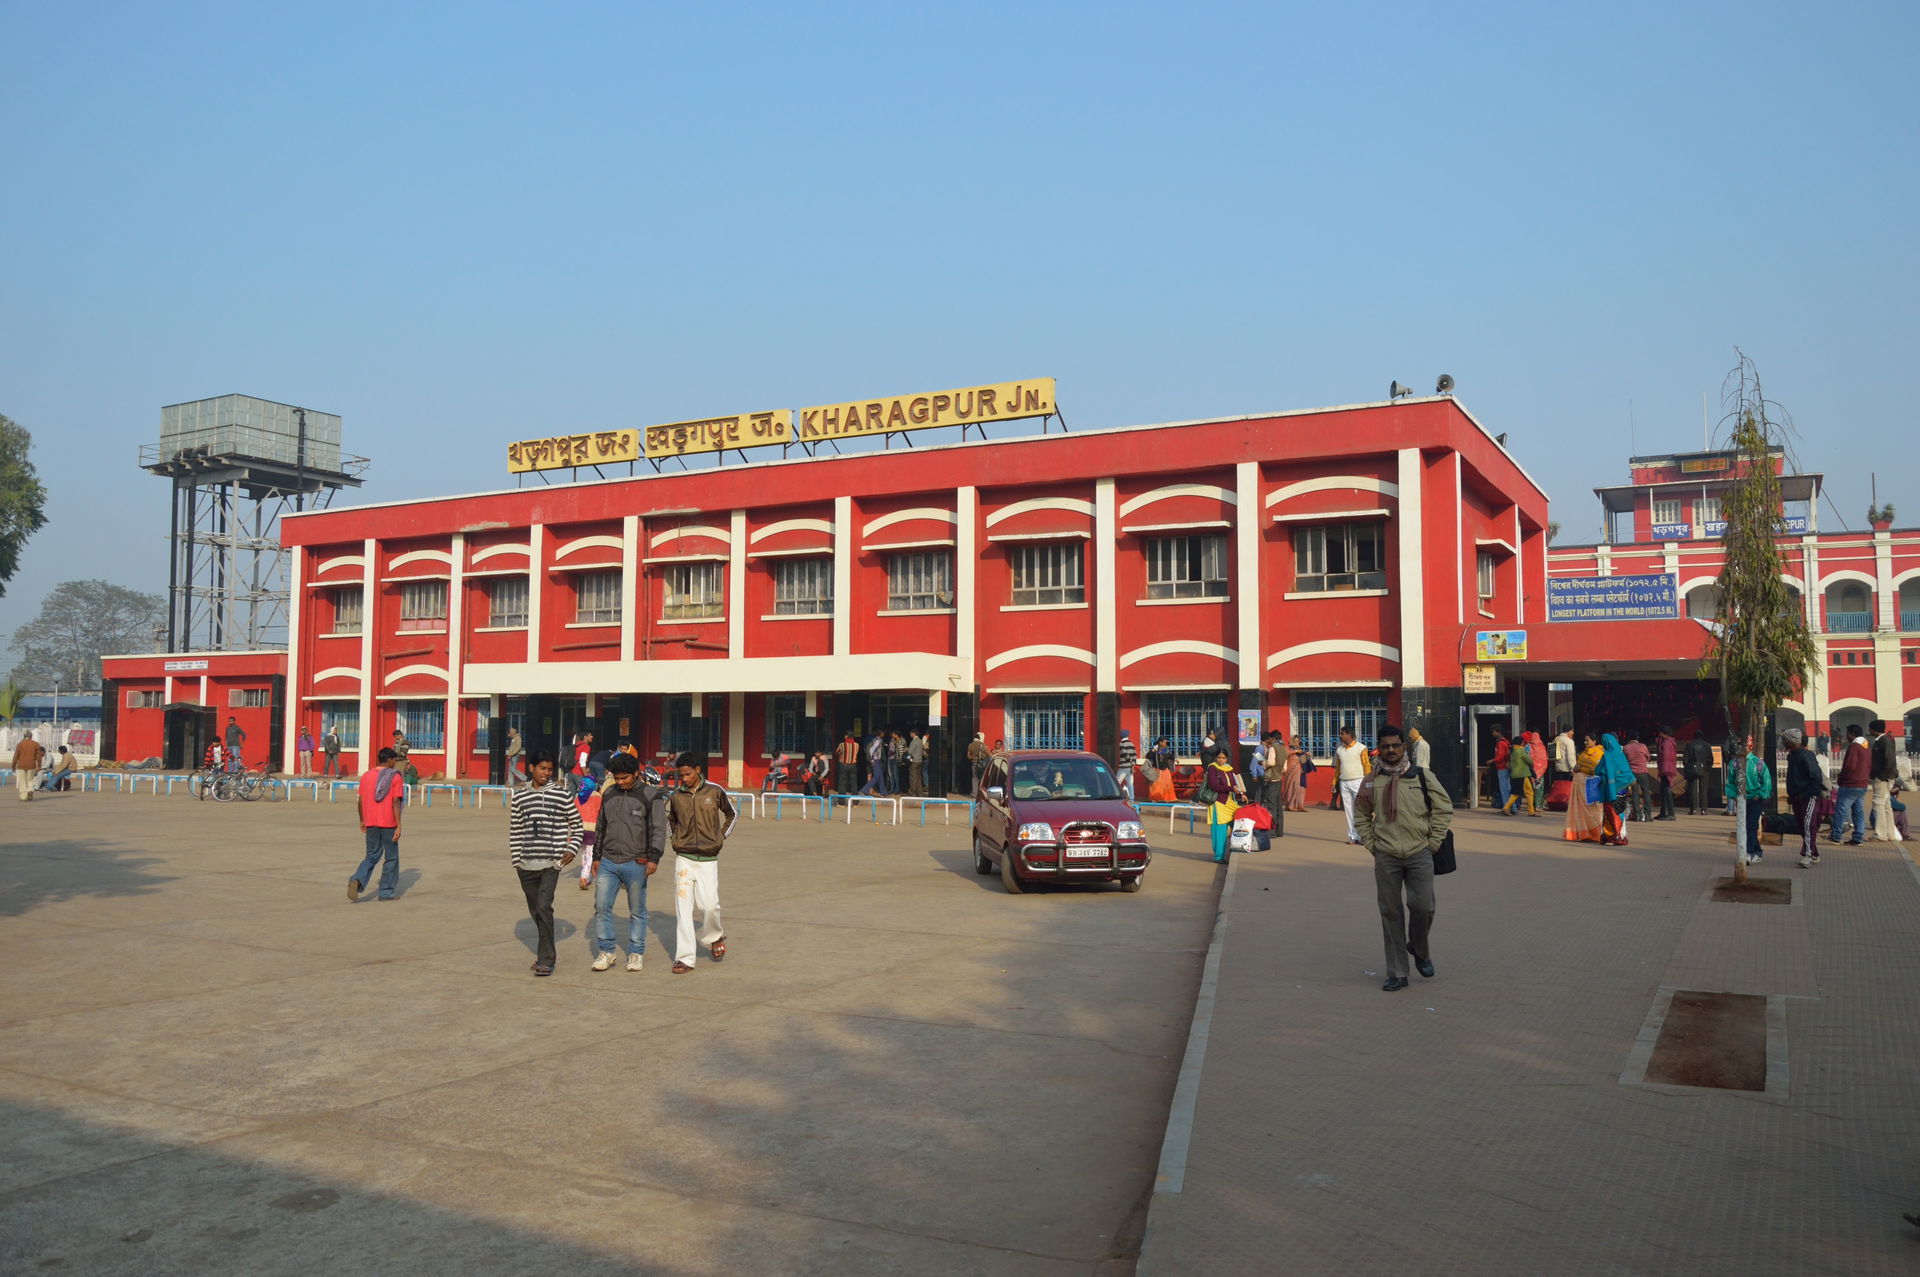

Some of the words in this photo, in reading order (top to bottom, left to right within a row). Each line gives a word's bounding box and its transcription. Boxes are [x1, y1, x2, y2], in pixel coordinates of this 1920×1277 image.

[802, 388, 997, 438] KHARAGPUR
[595, 432, 631, 456] জং
[646, 416, 740, 453] खड़गपुर
[1566, 595, 1573, 604] का
[1575, 591, 1589, 604] सबसे
[1551, 609, 1576, 618] LONGEST
[1577, 608, 1606, 617] PLATFORM
[1606, 608, 1613, 616] IN
[1613, 607, 1624, 616] THE
[1625, 606, 1645, 615] WORLD
[1646, 606, 1665, 616] (1072.5
